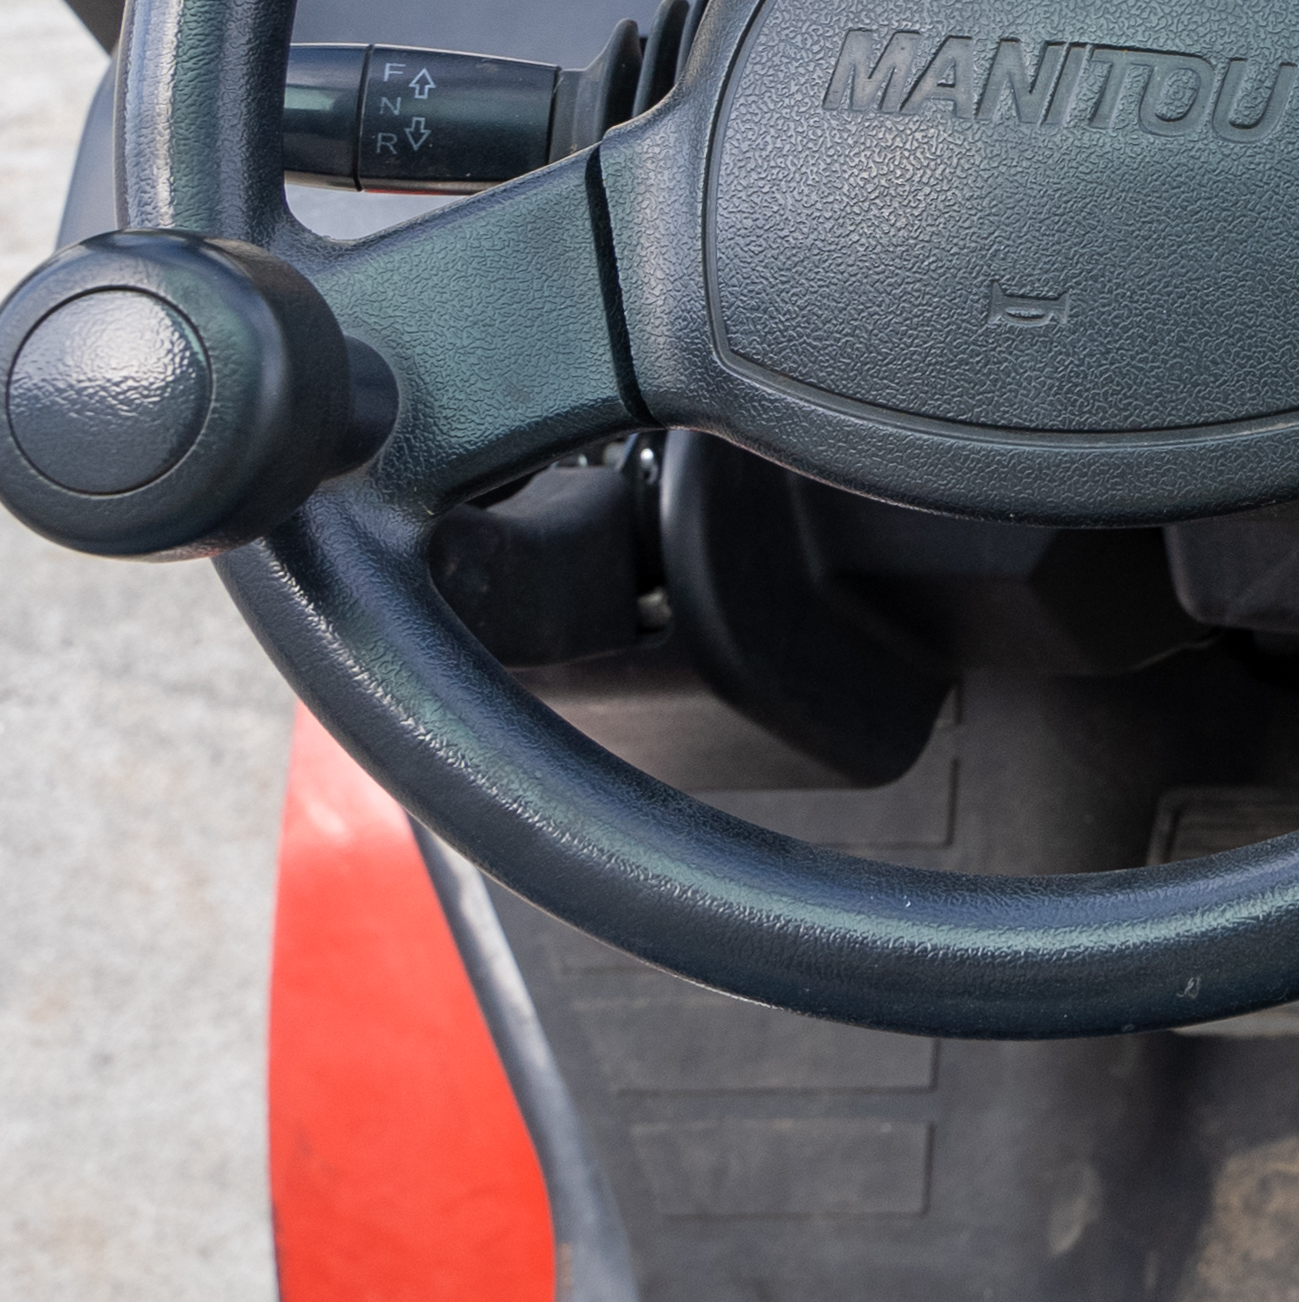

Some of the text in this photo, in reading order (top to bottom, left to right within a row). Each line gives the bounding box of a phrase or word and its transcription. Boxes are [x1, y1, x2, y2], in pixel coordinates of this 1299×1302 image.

[382, 62, 406, 82] F
[821, 27, 1298, 144] MANITOU
[379, 96, 401, 116] N
[375, 132, 398, 154] R
